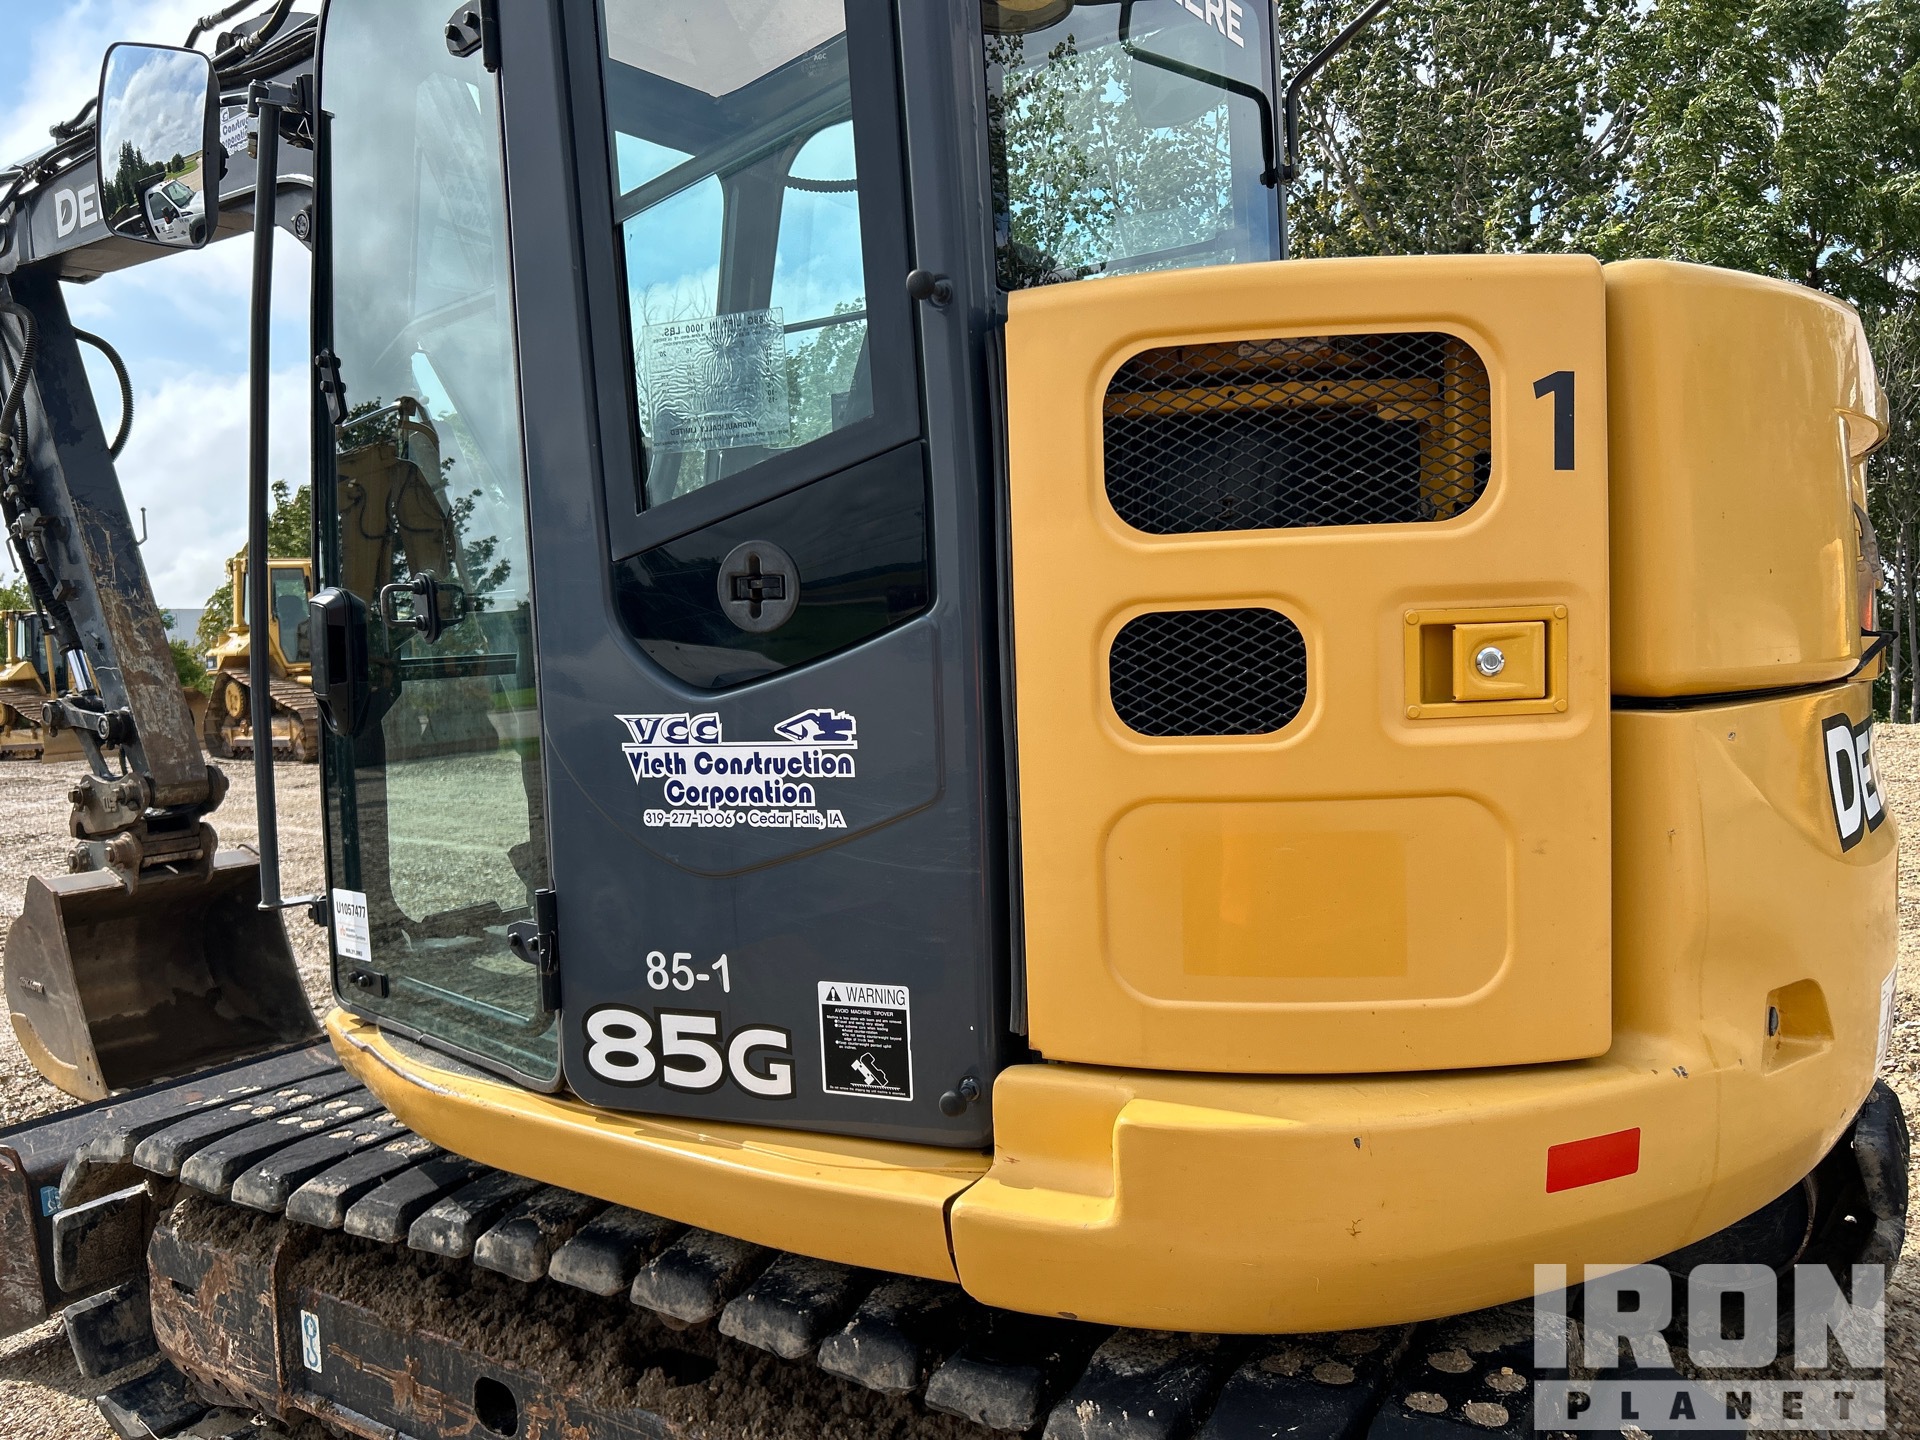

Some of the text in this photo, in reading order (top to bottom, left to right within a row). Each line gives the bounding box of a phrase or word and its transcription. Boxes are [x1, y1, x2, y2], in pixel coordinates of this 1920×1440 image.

[1532, 370, 1576, 471] 1
[618, 714, 722, 745] VCC
[629, 749, 852, 776] Vieth Construction
[666, 779, 812, 808] Corporation
[1826, 724, 1888, 840] DE
[645, 812, 842, 826] 319-277-1006 Cedar Falls, IA
[336, 901, 366, 918] U1057477
[646, 951, 730, 993] 85-1
[845, 986, 906, 1006] WARNING
[586, 1009, 792, 1096] 85G
